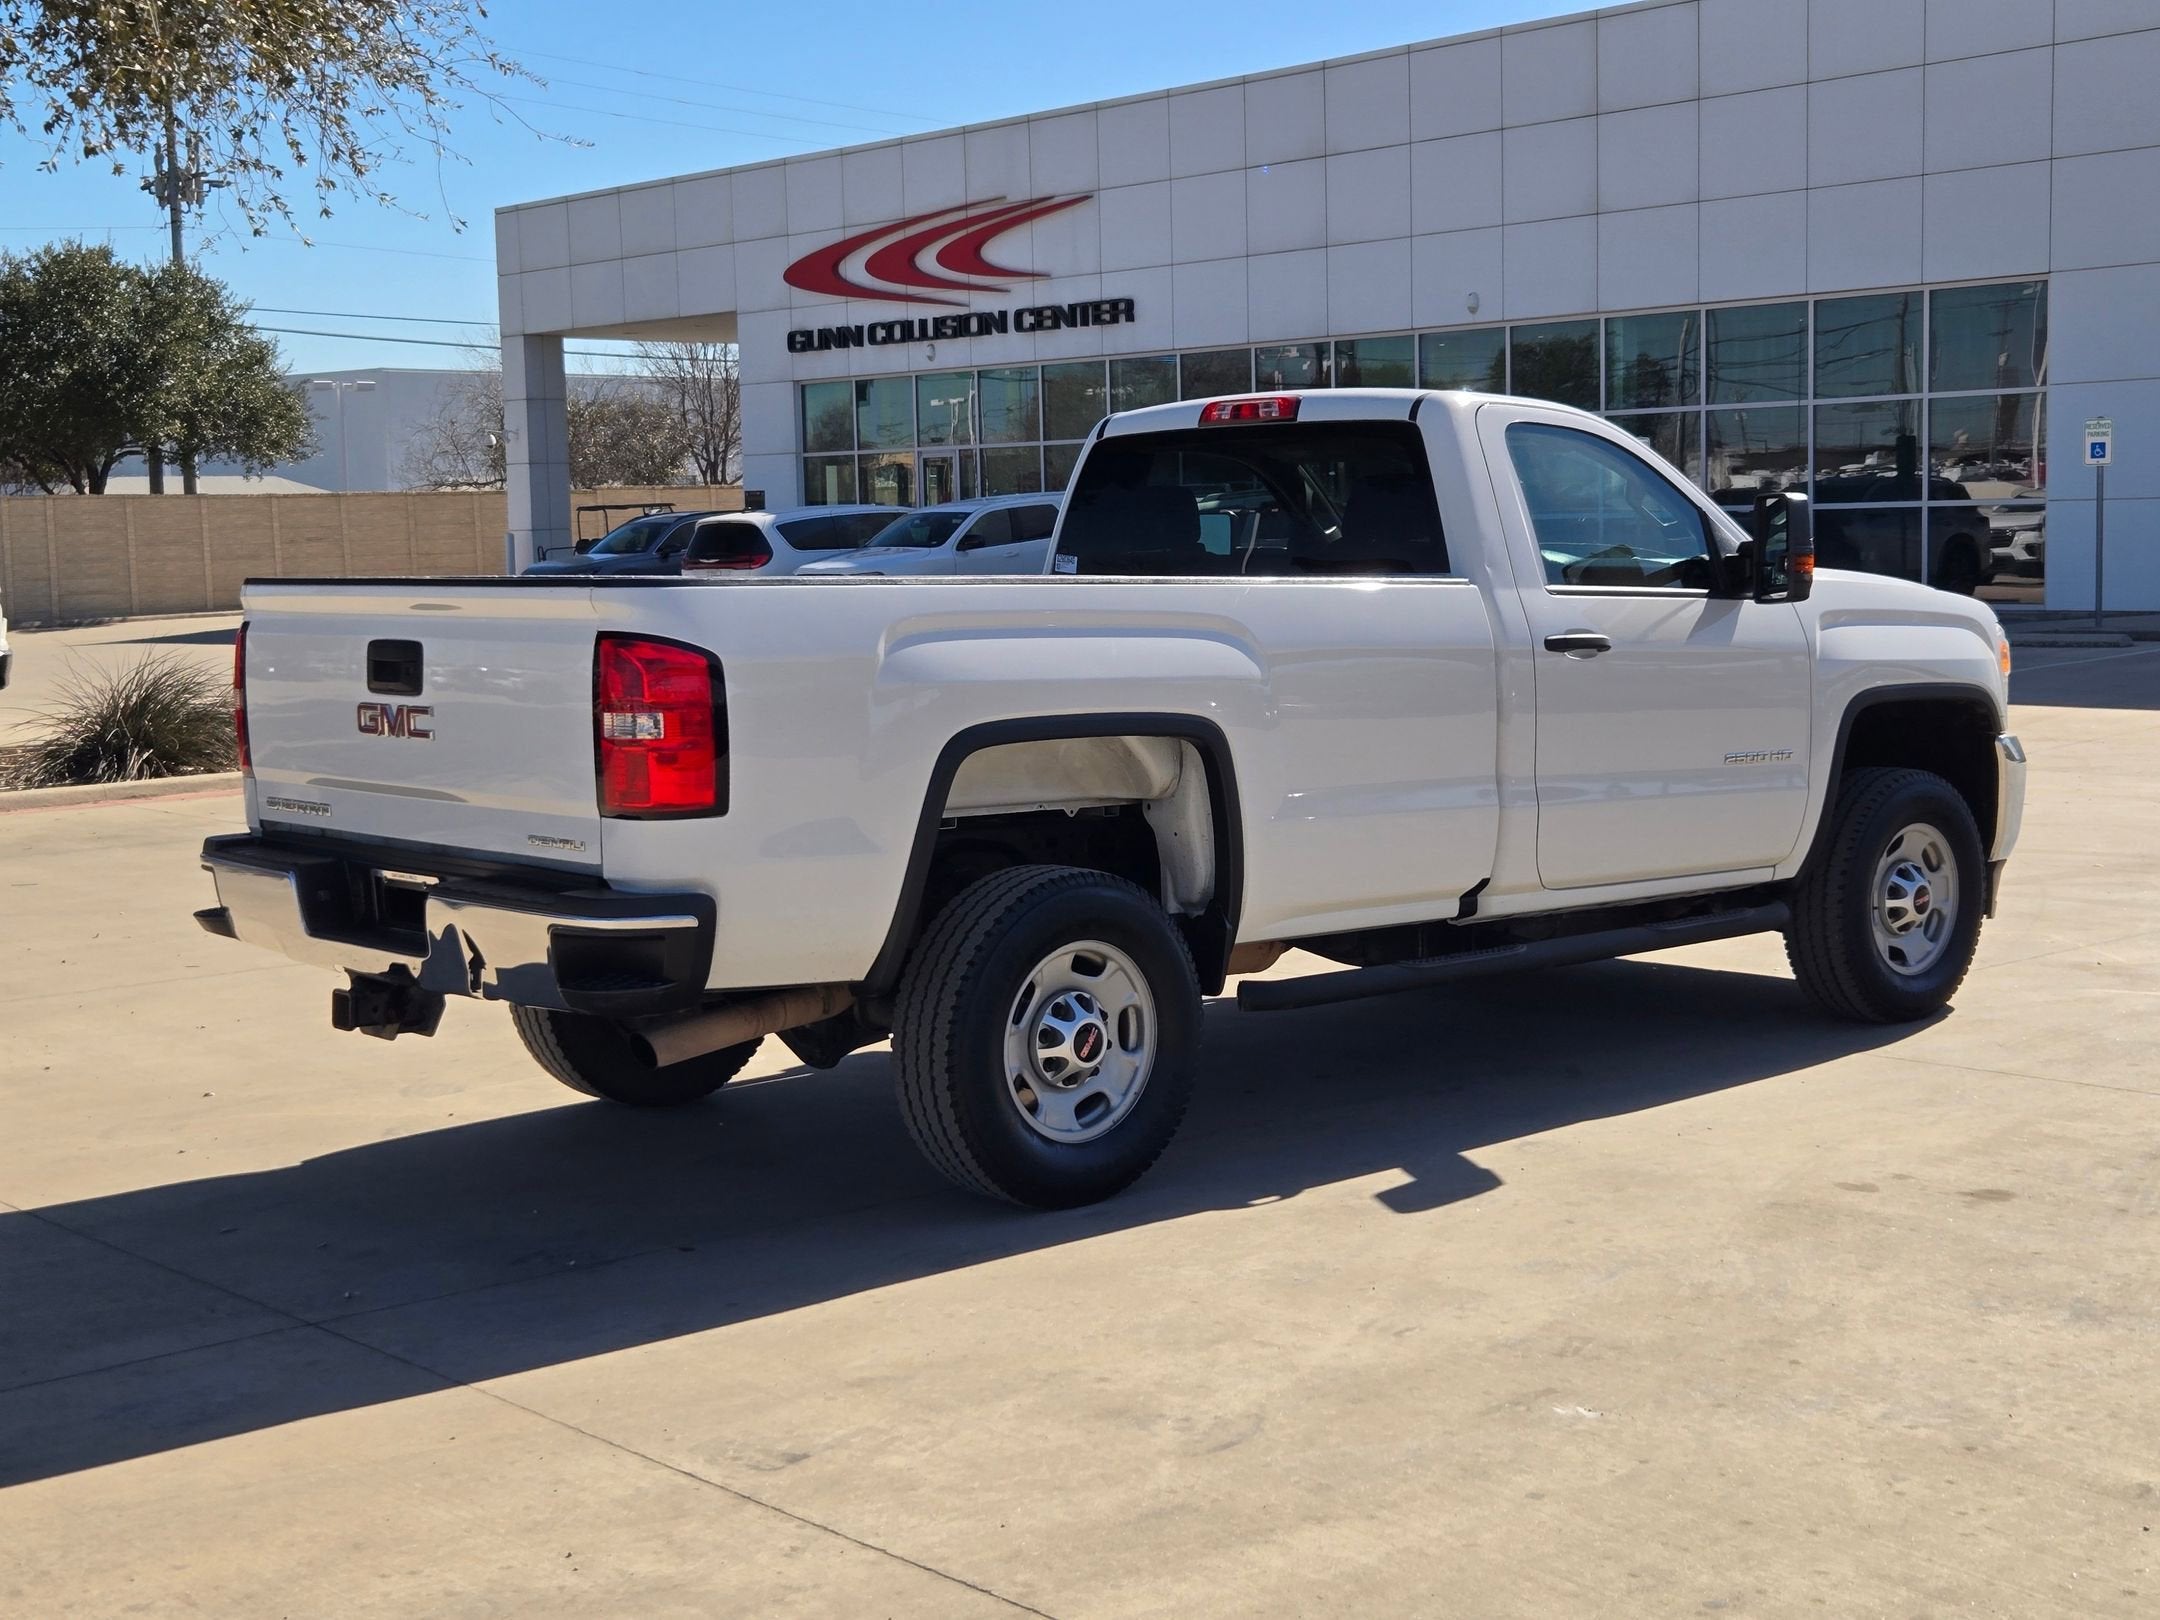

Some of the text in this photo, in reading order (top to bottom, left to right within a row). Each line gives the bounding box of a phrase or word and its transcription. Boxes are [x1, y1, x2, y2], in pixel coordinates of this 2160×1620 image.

[787, 298, 1135, 353] GUNN COLLISION CENTER
[357, 702, 435, 741] GMC
[527, 834, 585, 851] DENALI
[1080, 1026, 1098, 1058] GMC
